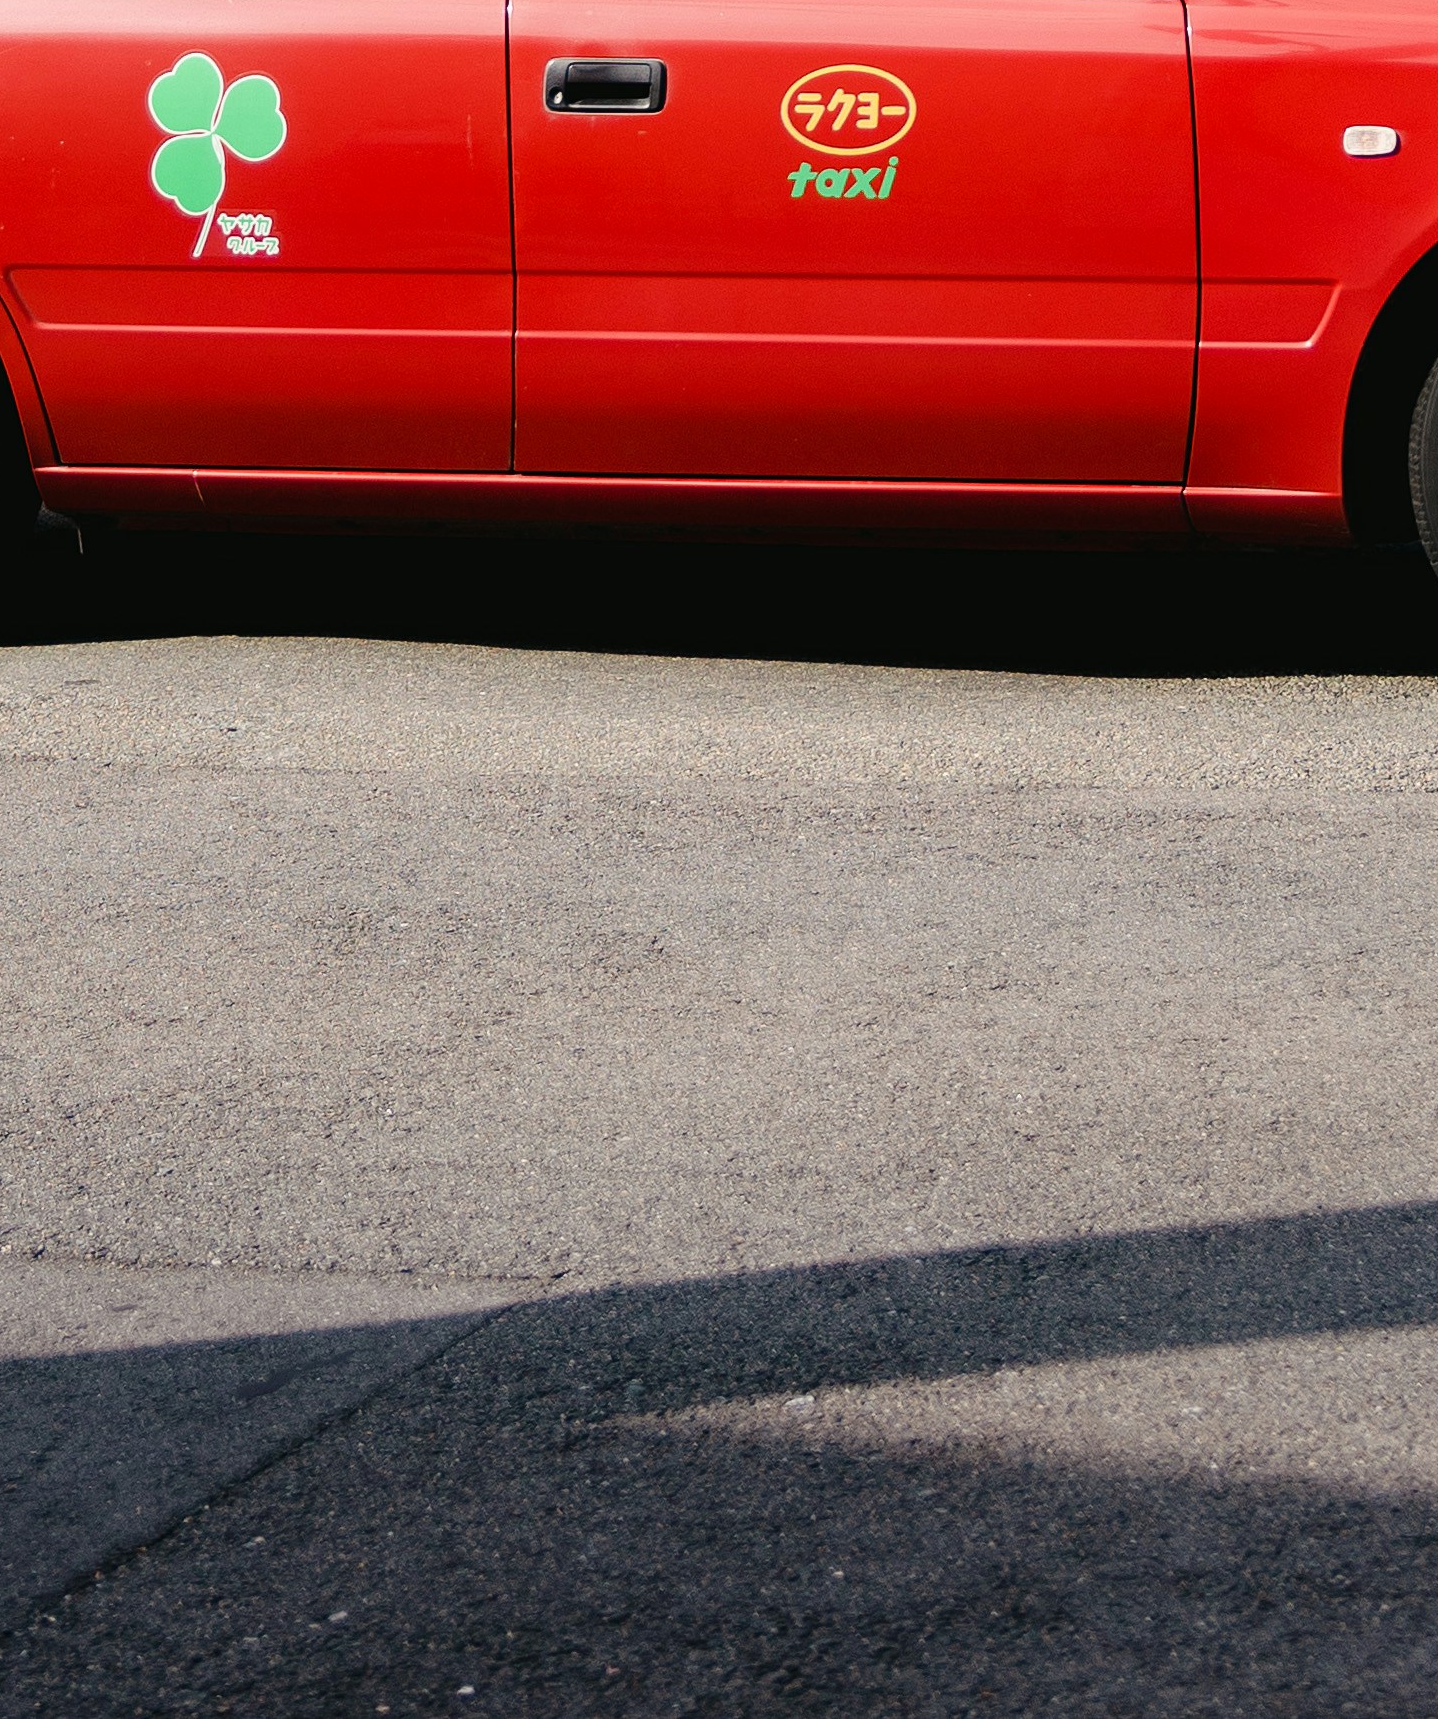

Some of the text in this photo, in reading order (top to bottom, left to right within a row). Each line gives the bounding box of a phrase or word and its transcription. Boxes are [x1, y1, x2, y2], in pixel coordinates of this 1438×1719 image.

[794, 88, 906, 132] ラクヨー
[787, 156, 899, 199] taxi
[217, 213, 272, 236] ヤサカ
